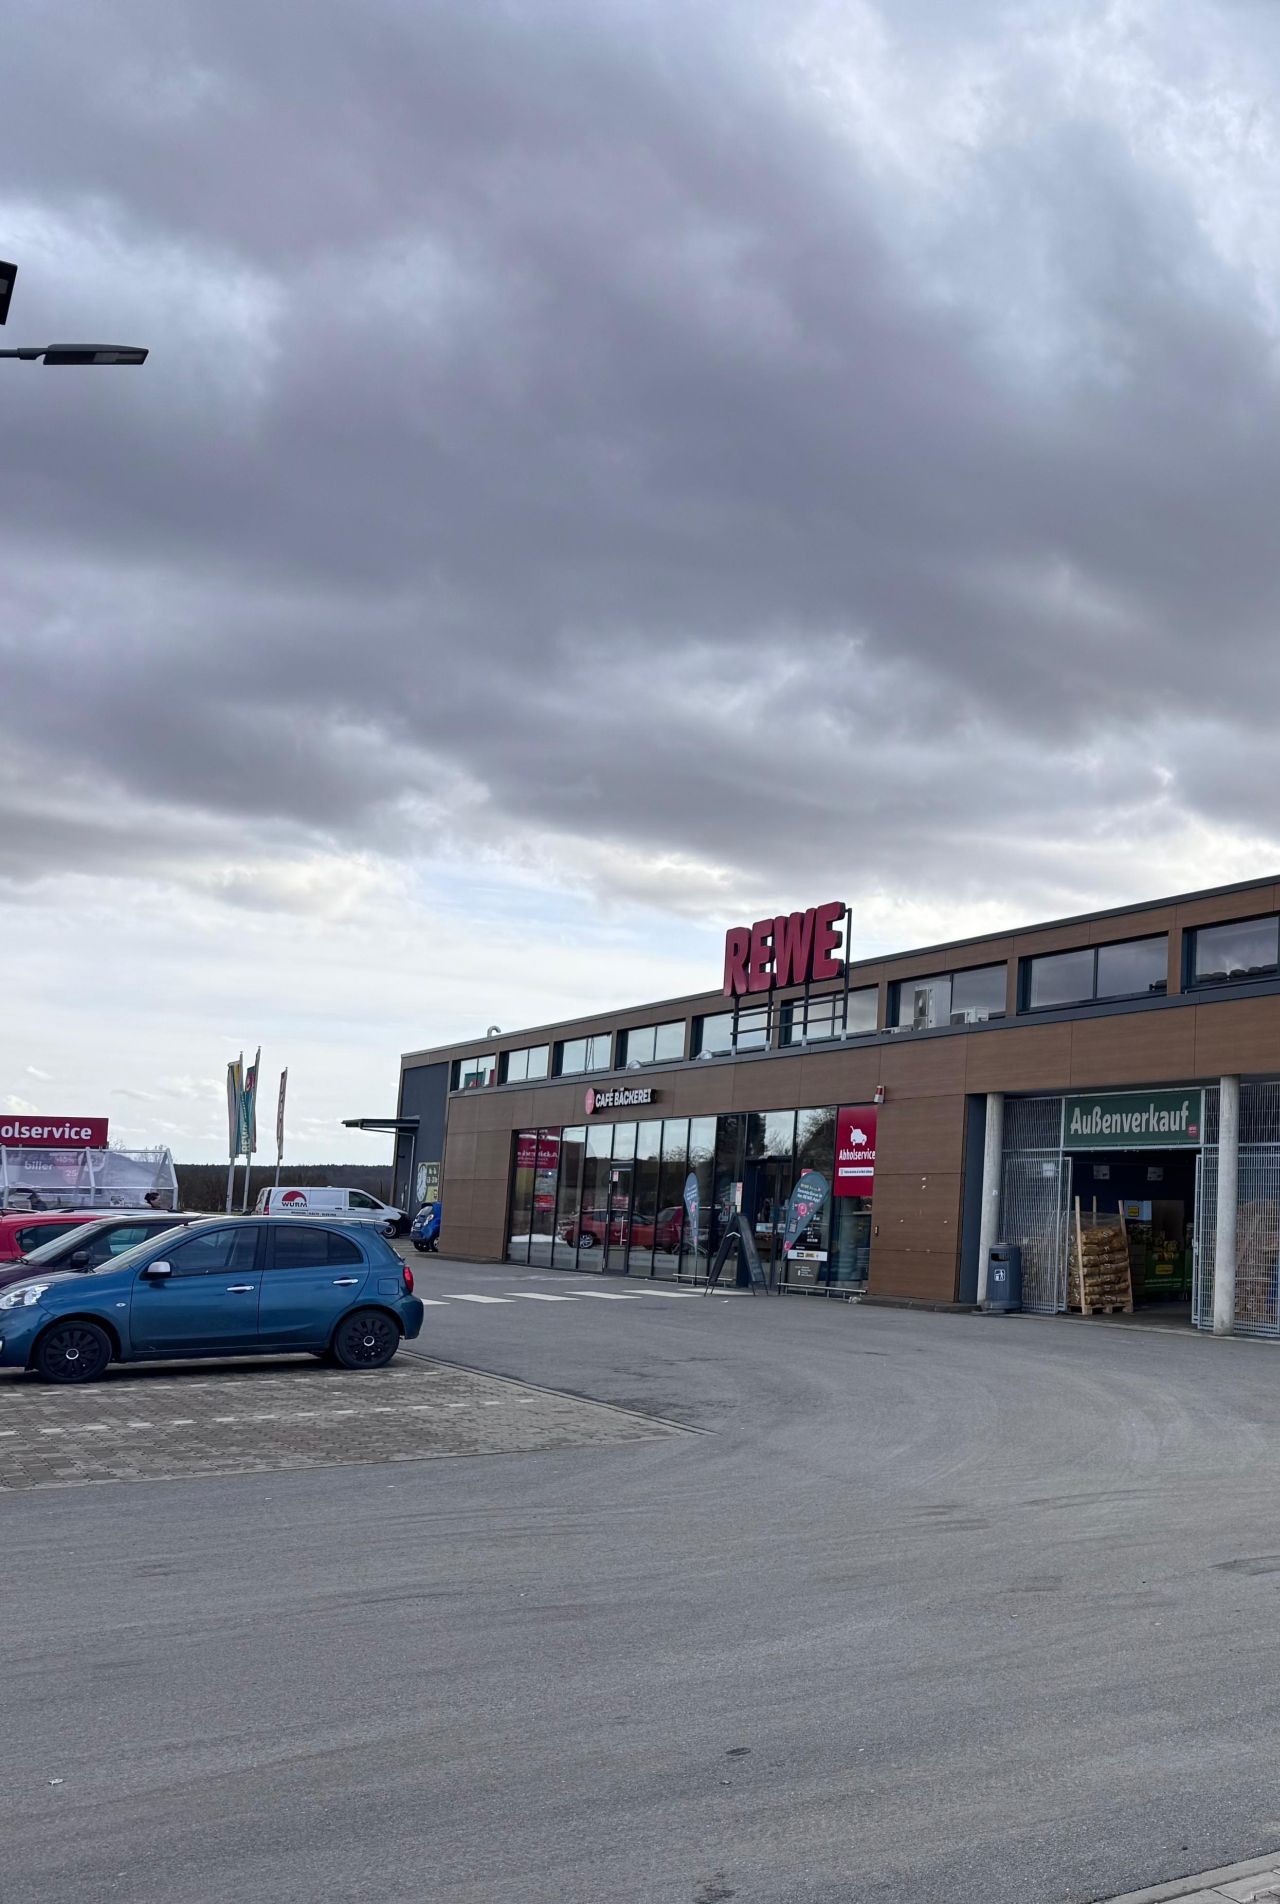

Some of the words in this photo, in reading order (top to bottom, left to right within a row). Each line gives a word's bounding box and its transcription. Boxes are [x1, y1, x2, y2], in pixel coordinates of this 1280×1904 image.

[723, 901, 846, 998] REWE
[595, 1088, 613, 1108] CAFÉ
[614, 1087, 652, 1106] BÄCKEREI
[1070, 1100, 1189, 1135] Außenverkauf
[1, 1121, 92, 1140] olservice
[838, 1148, 876, 1161] Abholservice
